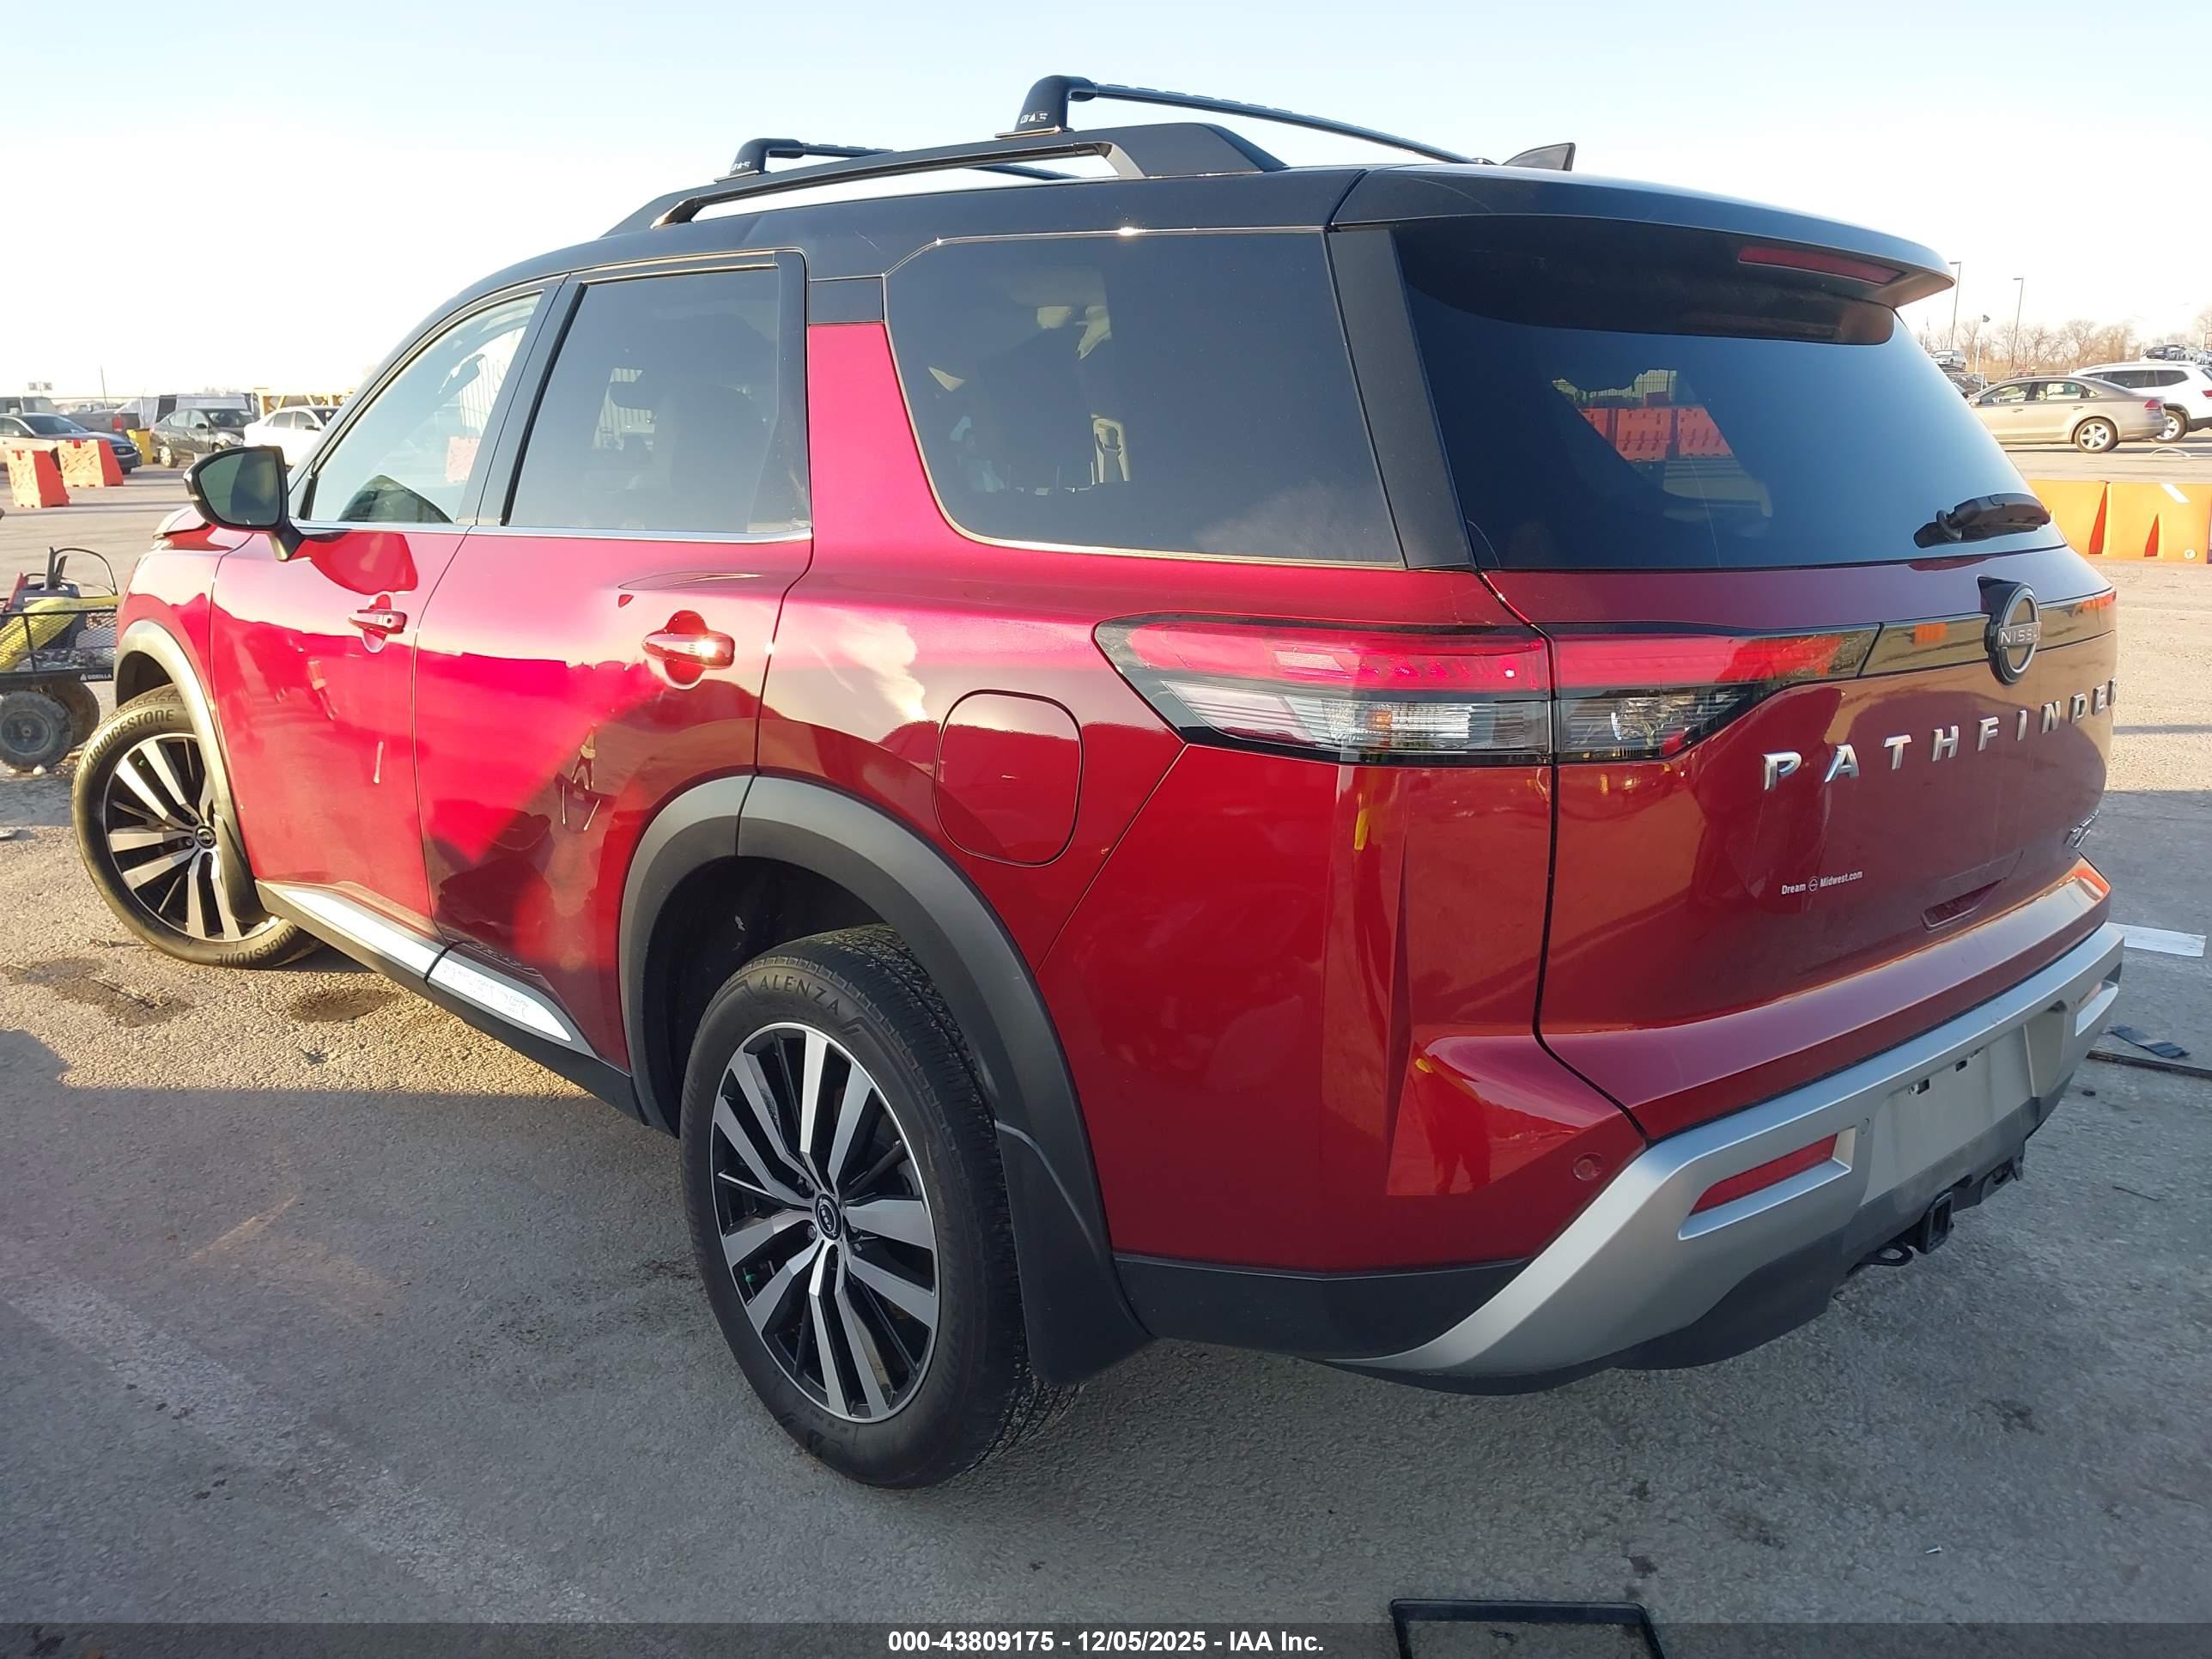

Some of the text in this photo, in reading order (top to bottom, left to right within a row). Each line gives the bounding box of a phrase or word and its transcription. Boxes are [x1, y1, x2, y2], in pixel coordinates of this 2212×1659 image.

[1781, 871, 1863, 895] Dream Midwest.com
[759, 974, 840, 1016] ALENZA
